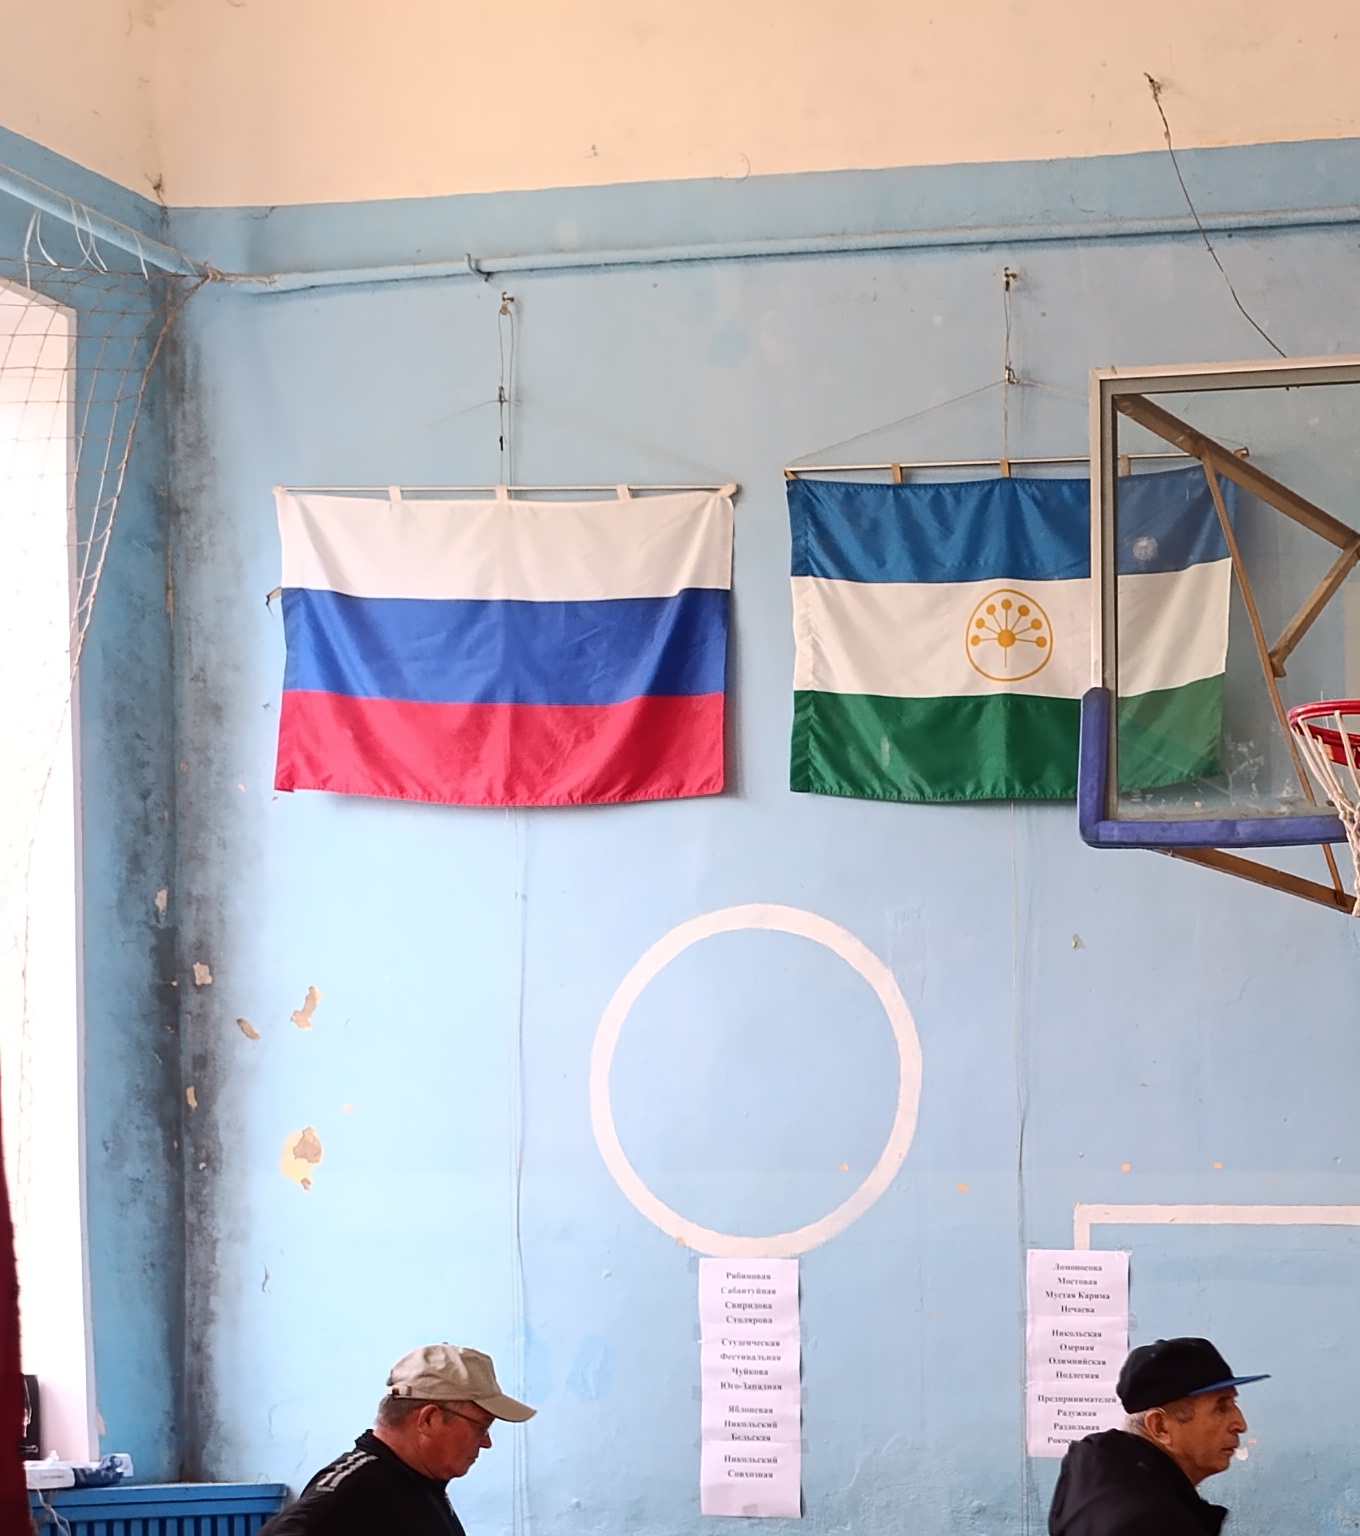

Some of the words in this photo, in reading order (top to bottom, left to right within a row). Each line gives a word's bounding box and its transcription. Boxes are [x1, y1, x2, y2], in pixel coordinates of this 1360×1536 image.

[1053, 1263, 1102, 1271] Ломоносова
[1057, 1277, 1097, 1285] Мостовая
[1045, 1291, 1076, 1300] Мустая
[1079, 1292, 1110, 1301] Карима
[721, 1338, 780, 1347] Студенческая
[720, 1353, 781, 1361] Фестивальная
[732, 1367, 768, 1377] Чуйкова
[720, 1382, 782, 1390] Юго-Западная
[1057, 1409, 1097, 1418] Радужная
